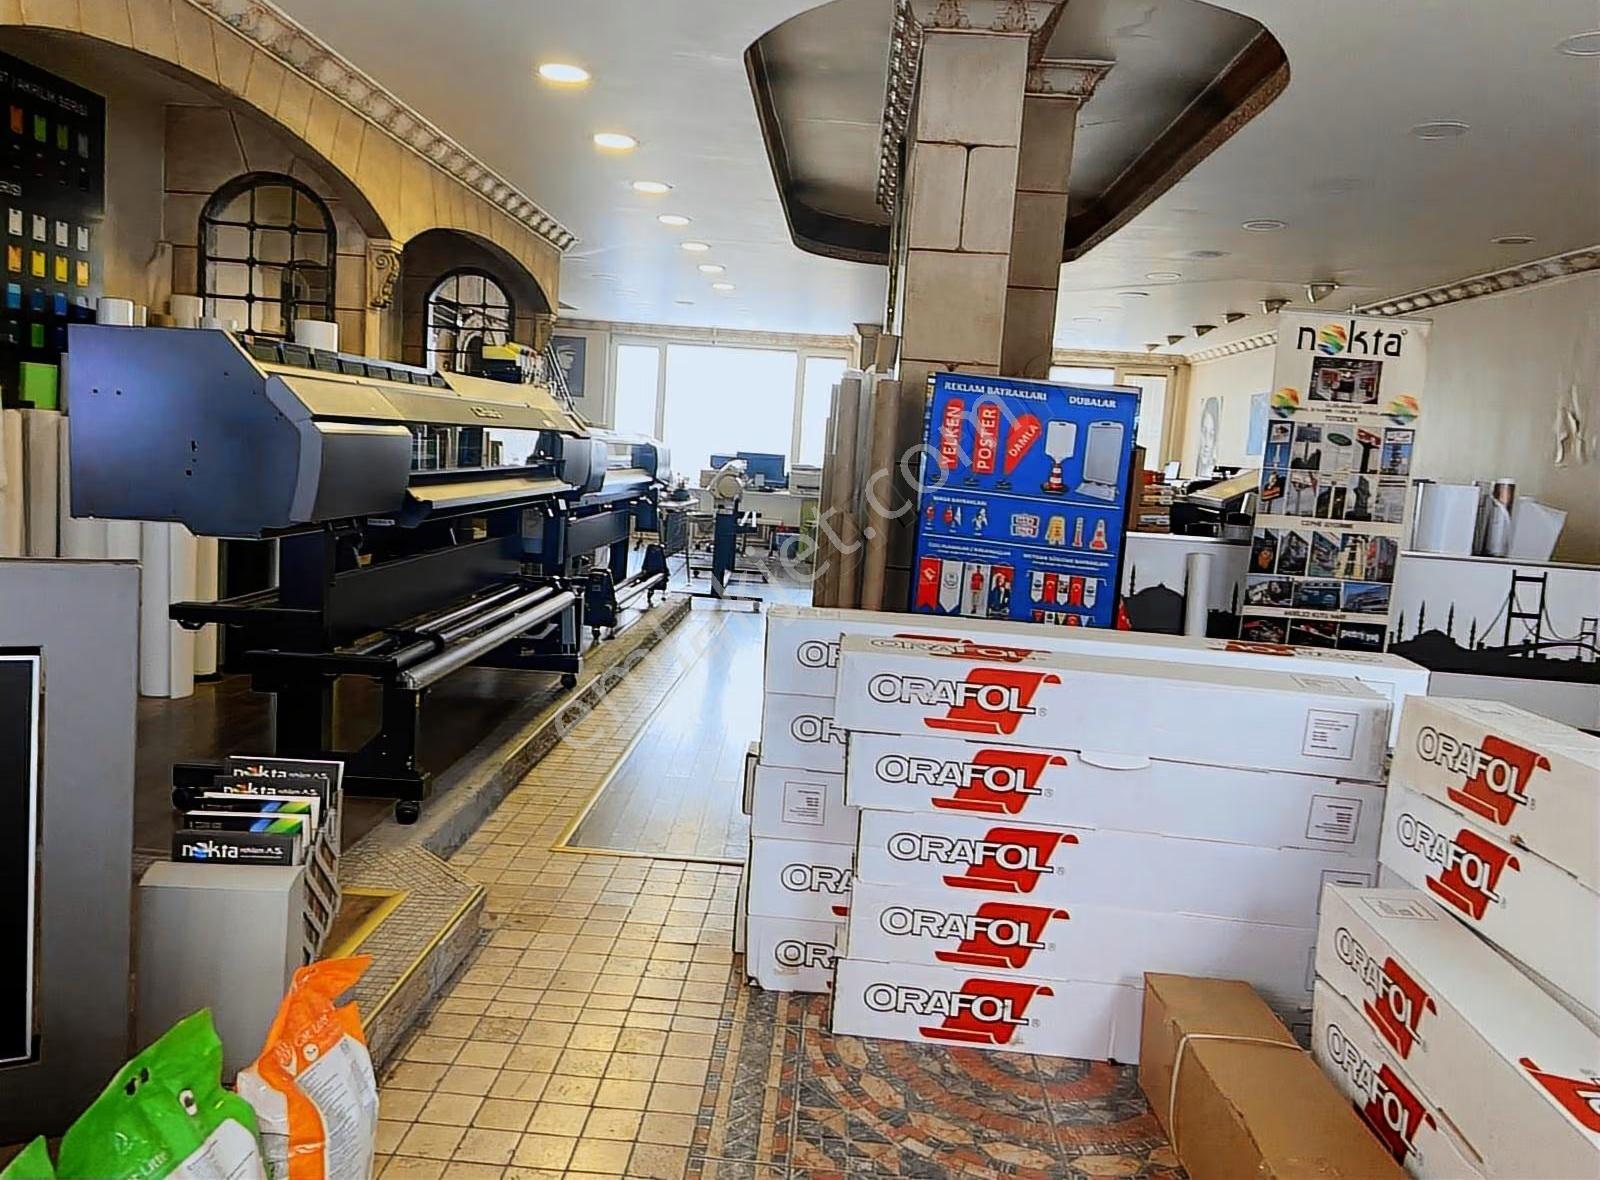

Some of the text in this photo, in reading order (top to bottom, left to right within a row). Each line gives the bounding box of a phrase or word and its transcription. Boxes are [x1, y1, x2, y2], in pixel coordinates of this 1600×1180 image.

[1297, 320, 1402, 357] nokta
[944, 381, 1047, 401] REKLAM BAYRAKLARI
[1068, 394, 1117, 409] DUBALAR
[940, 405, 963, 467] YELKEN
[977, 407, 998, 470] POSTER
[1009, 425, 1040, 457] DAMLA
[870, 638, 1038, 660] ORAFOL
[868, 673, 1036, 715] ORAFOL
[233, 765, 287, 779] nokta
[875, 754, 1042, 796] ORAFOL
[1416, 726, 1528, 806] ORAFOL
[223, 782, 277, 796] nokta
[181, 840, 239, 861] nokta
[887, 832, 1054, 874] ORAFOL
[1397, 812, 1500, 904] ORAFOL
[880, 906, 1045, 949] ORAFOL
[864, 982, 1029, 1026] ORAFOL
[1334, 927, 1425, 1047] ORAFOL
[1327, 1023, 1419, 1158] ORAFOL
